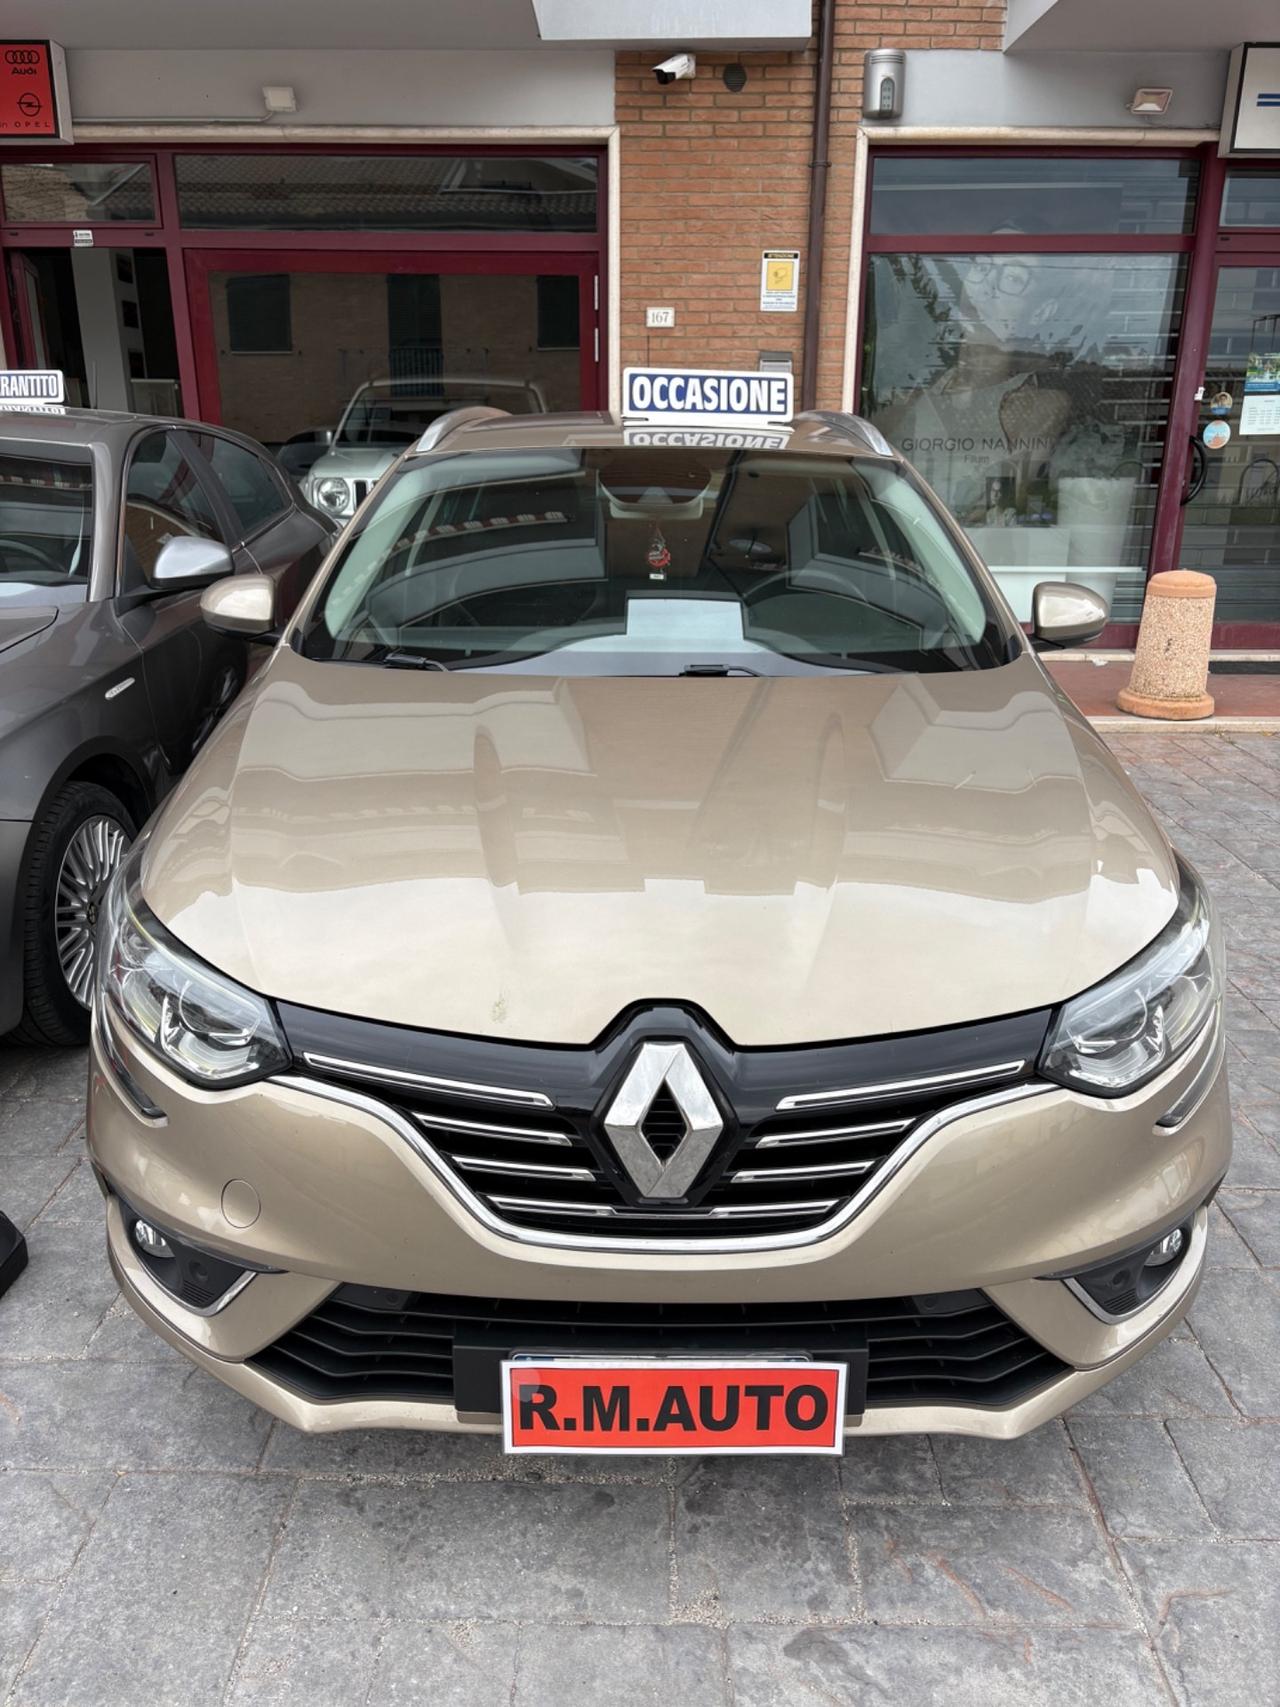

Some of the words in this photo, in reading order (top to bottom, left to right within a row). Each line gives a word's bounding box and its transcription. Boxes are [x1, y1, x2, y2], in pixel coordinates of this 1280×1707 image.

[12, 67, 37, 75] Audi
[651, 311, 670, 323] 167
[0, 375, 58, 397] RANTITO
[632, 376, 785, 412] OCCASIONE
[901, 438, 975, 451] GIORGIO
[519, 1384, 829, 1432] R.M.AUTO
